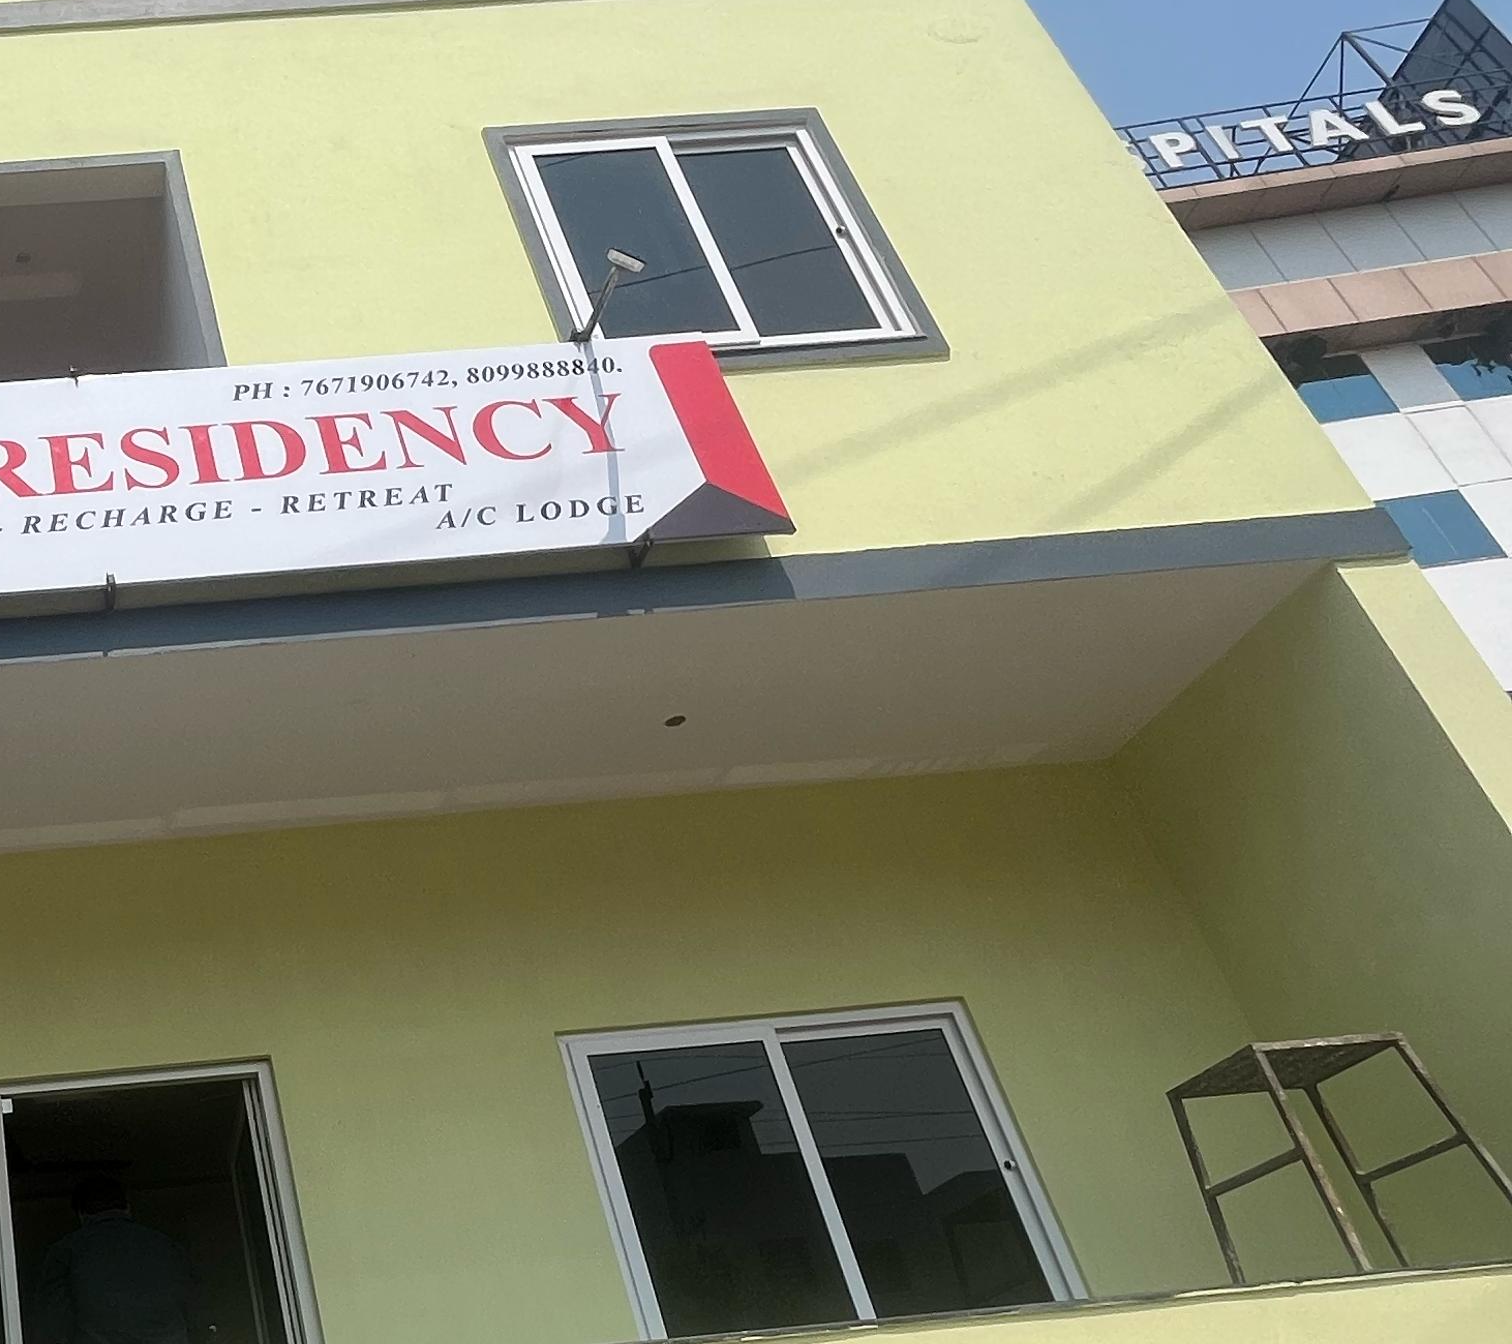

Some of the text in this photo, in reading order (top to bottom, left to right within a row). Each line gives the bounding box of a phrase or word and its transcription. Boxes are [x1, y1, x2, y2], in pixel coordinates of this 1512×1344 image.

[1128, 89, 1483, 173] PITALS
[232, 382, 273, 402] PH
[300, 369, 458, 397] 7671906742,
[466, 357, 622, 384] 8099888840.
[21, 500, 233, 535] RECHARGE
[281, 483, 453, 515] RETREAT
[435, 494, 645, 530] A/C LODGE
